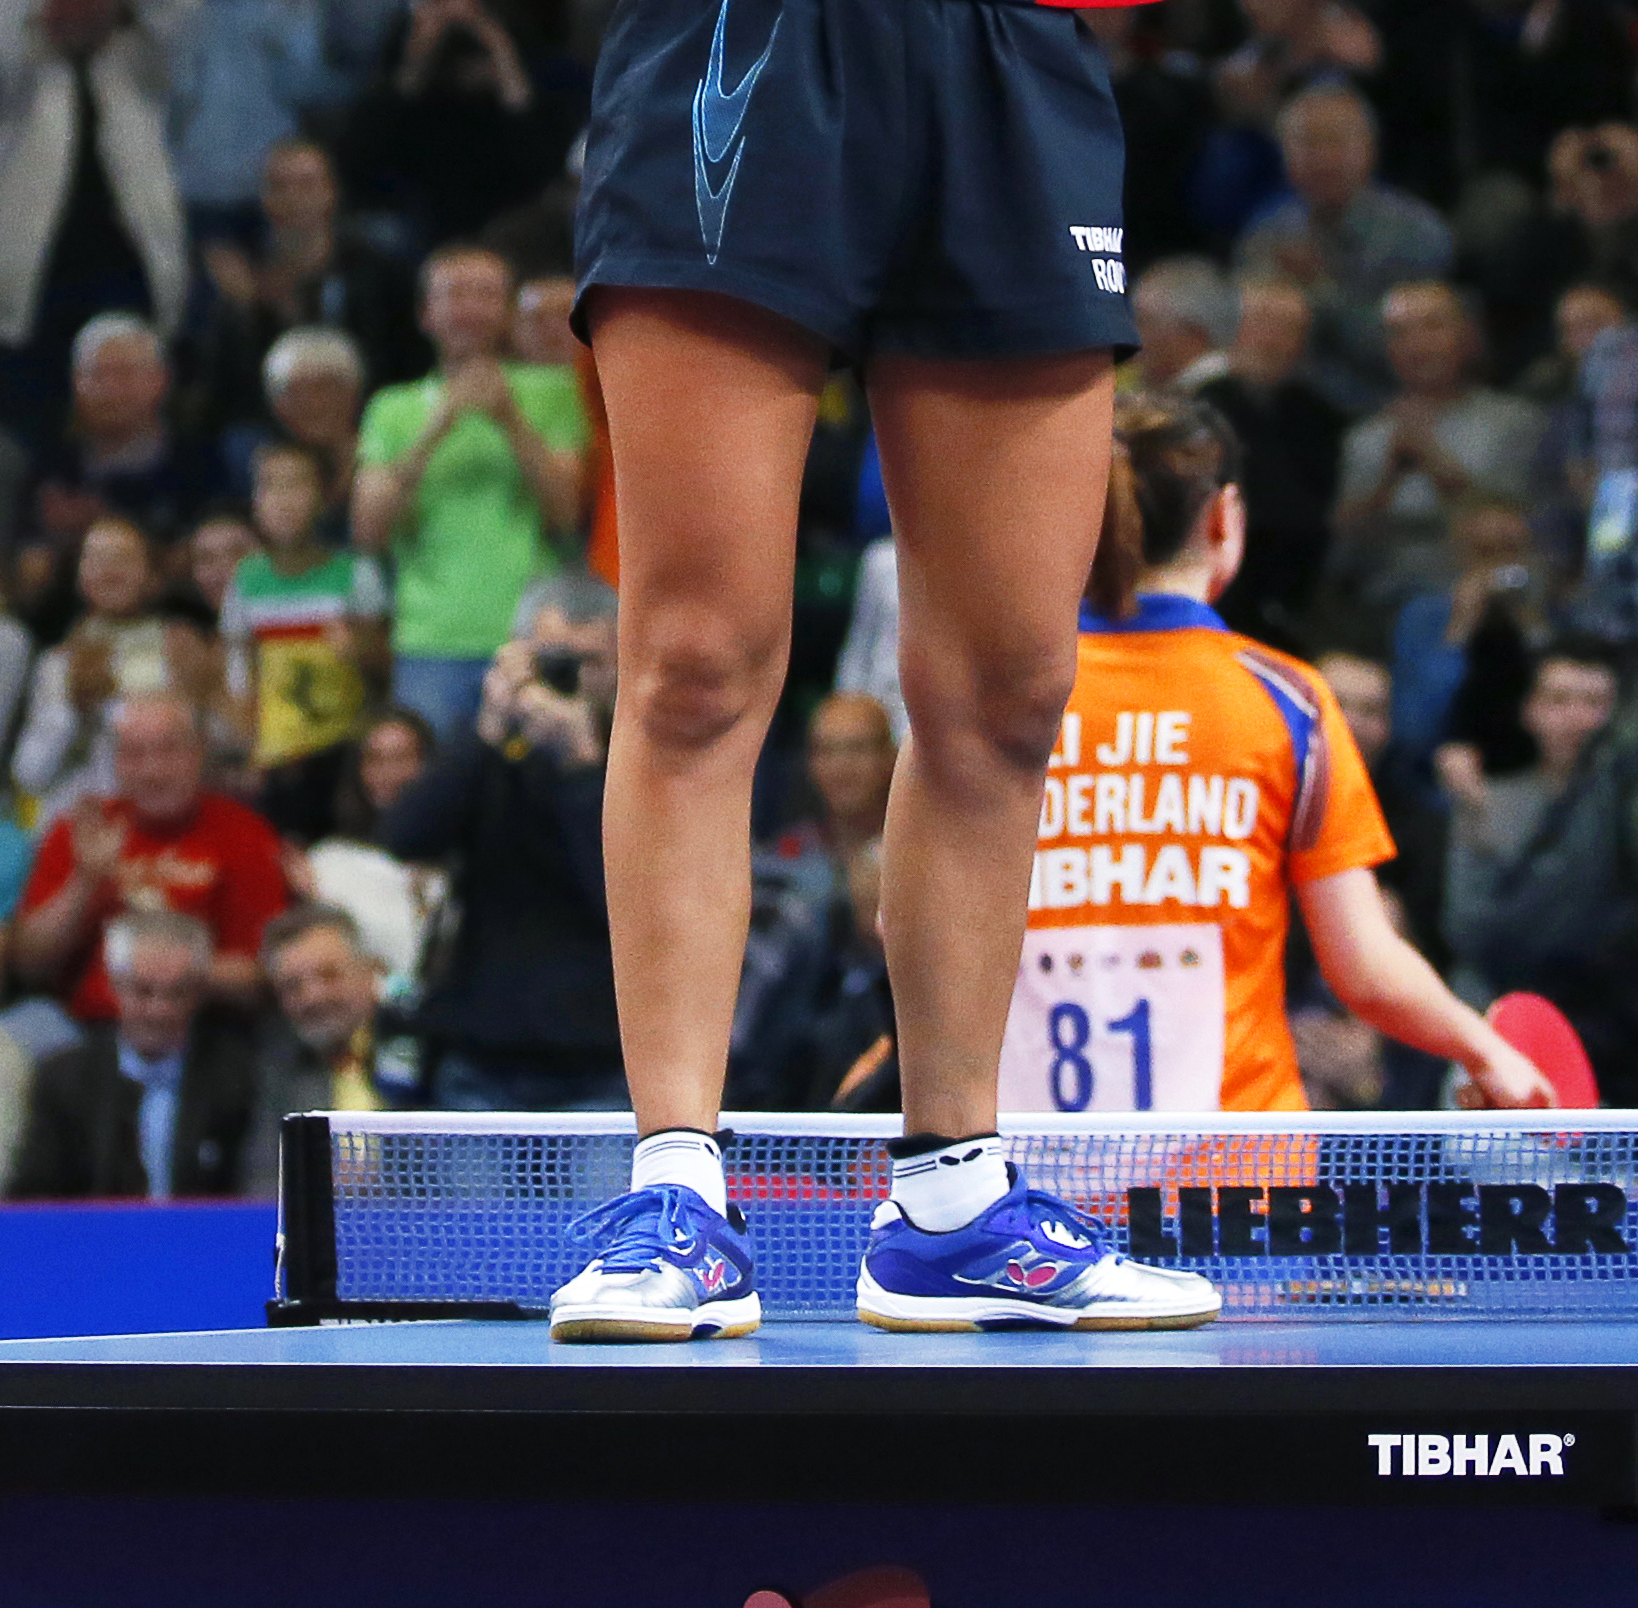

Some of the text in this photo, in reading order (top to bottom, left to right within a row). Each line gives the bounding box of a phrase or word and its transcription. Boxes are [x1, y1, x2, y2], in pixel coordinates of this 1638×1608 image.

[1095, 710, 1192, 768] JIE
[1049, 997, 1154, 1113] 81
[1127, 1181, 1629, 1257] LIEBHERR
